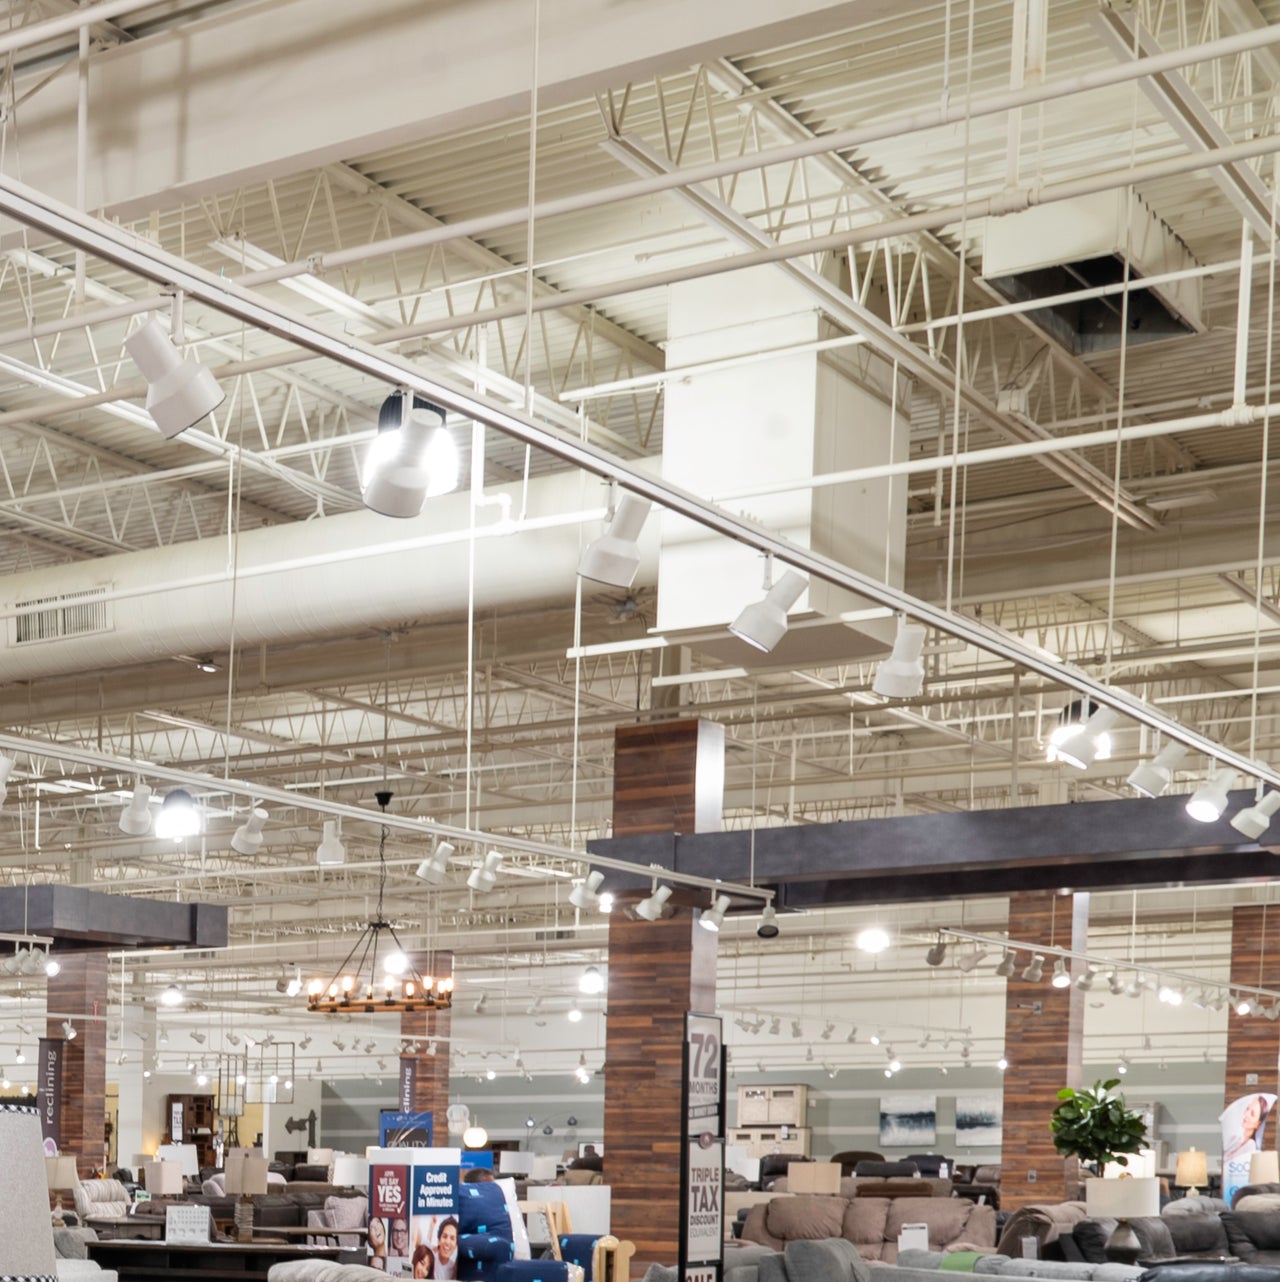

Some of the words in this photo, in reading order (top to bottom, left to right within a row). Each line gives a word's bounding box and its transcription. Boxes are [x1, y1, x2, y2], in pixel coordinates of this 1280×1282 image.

[691, 1032, 718, 1079] 72
[45, 1050, 57, 1125] reclining
[689, 1080, 718, 1095] MONTHS
[426, 1172, 447, 1183] Credit
[691, 1167, 719, 1182] TRIPLE
[377, 1185, 401, 1203] YES
[420, 1184, 452, 1196] Approved
[418, 1197, 425, 1207] in
[426, 1197, 453, 1208] Minutes
[691, 1185, 719, 1212] TAX
[690, 1214, 719, 1226] DISCOUNT
